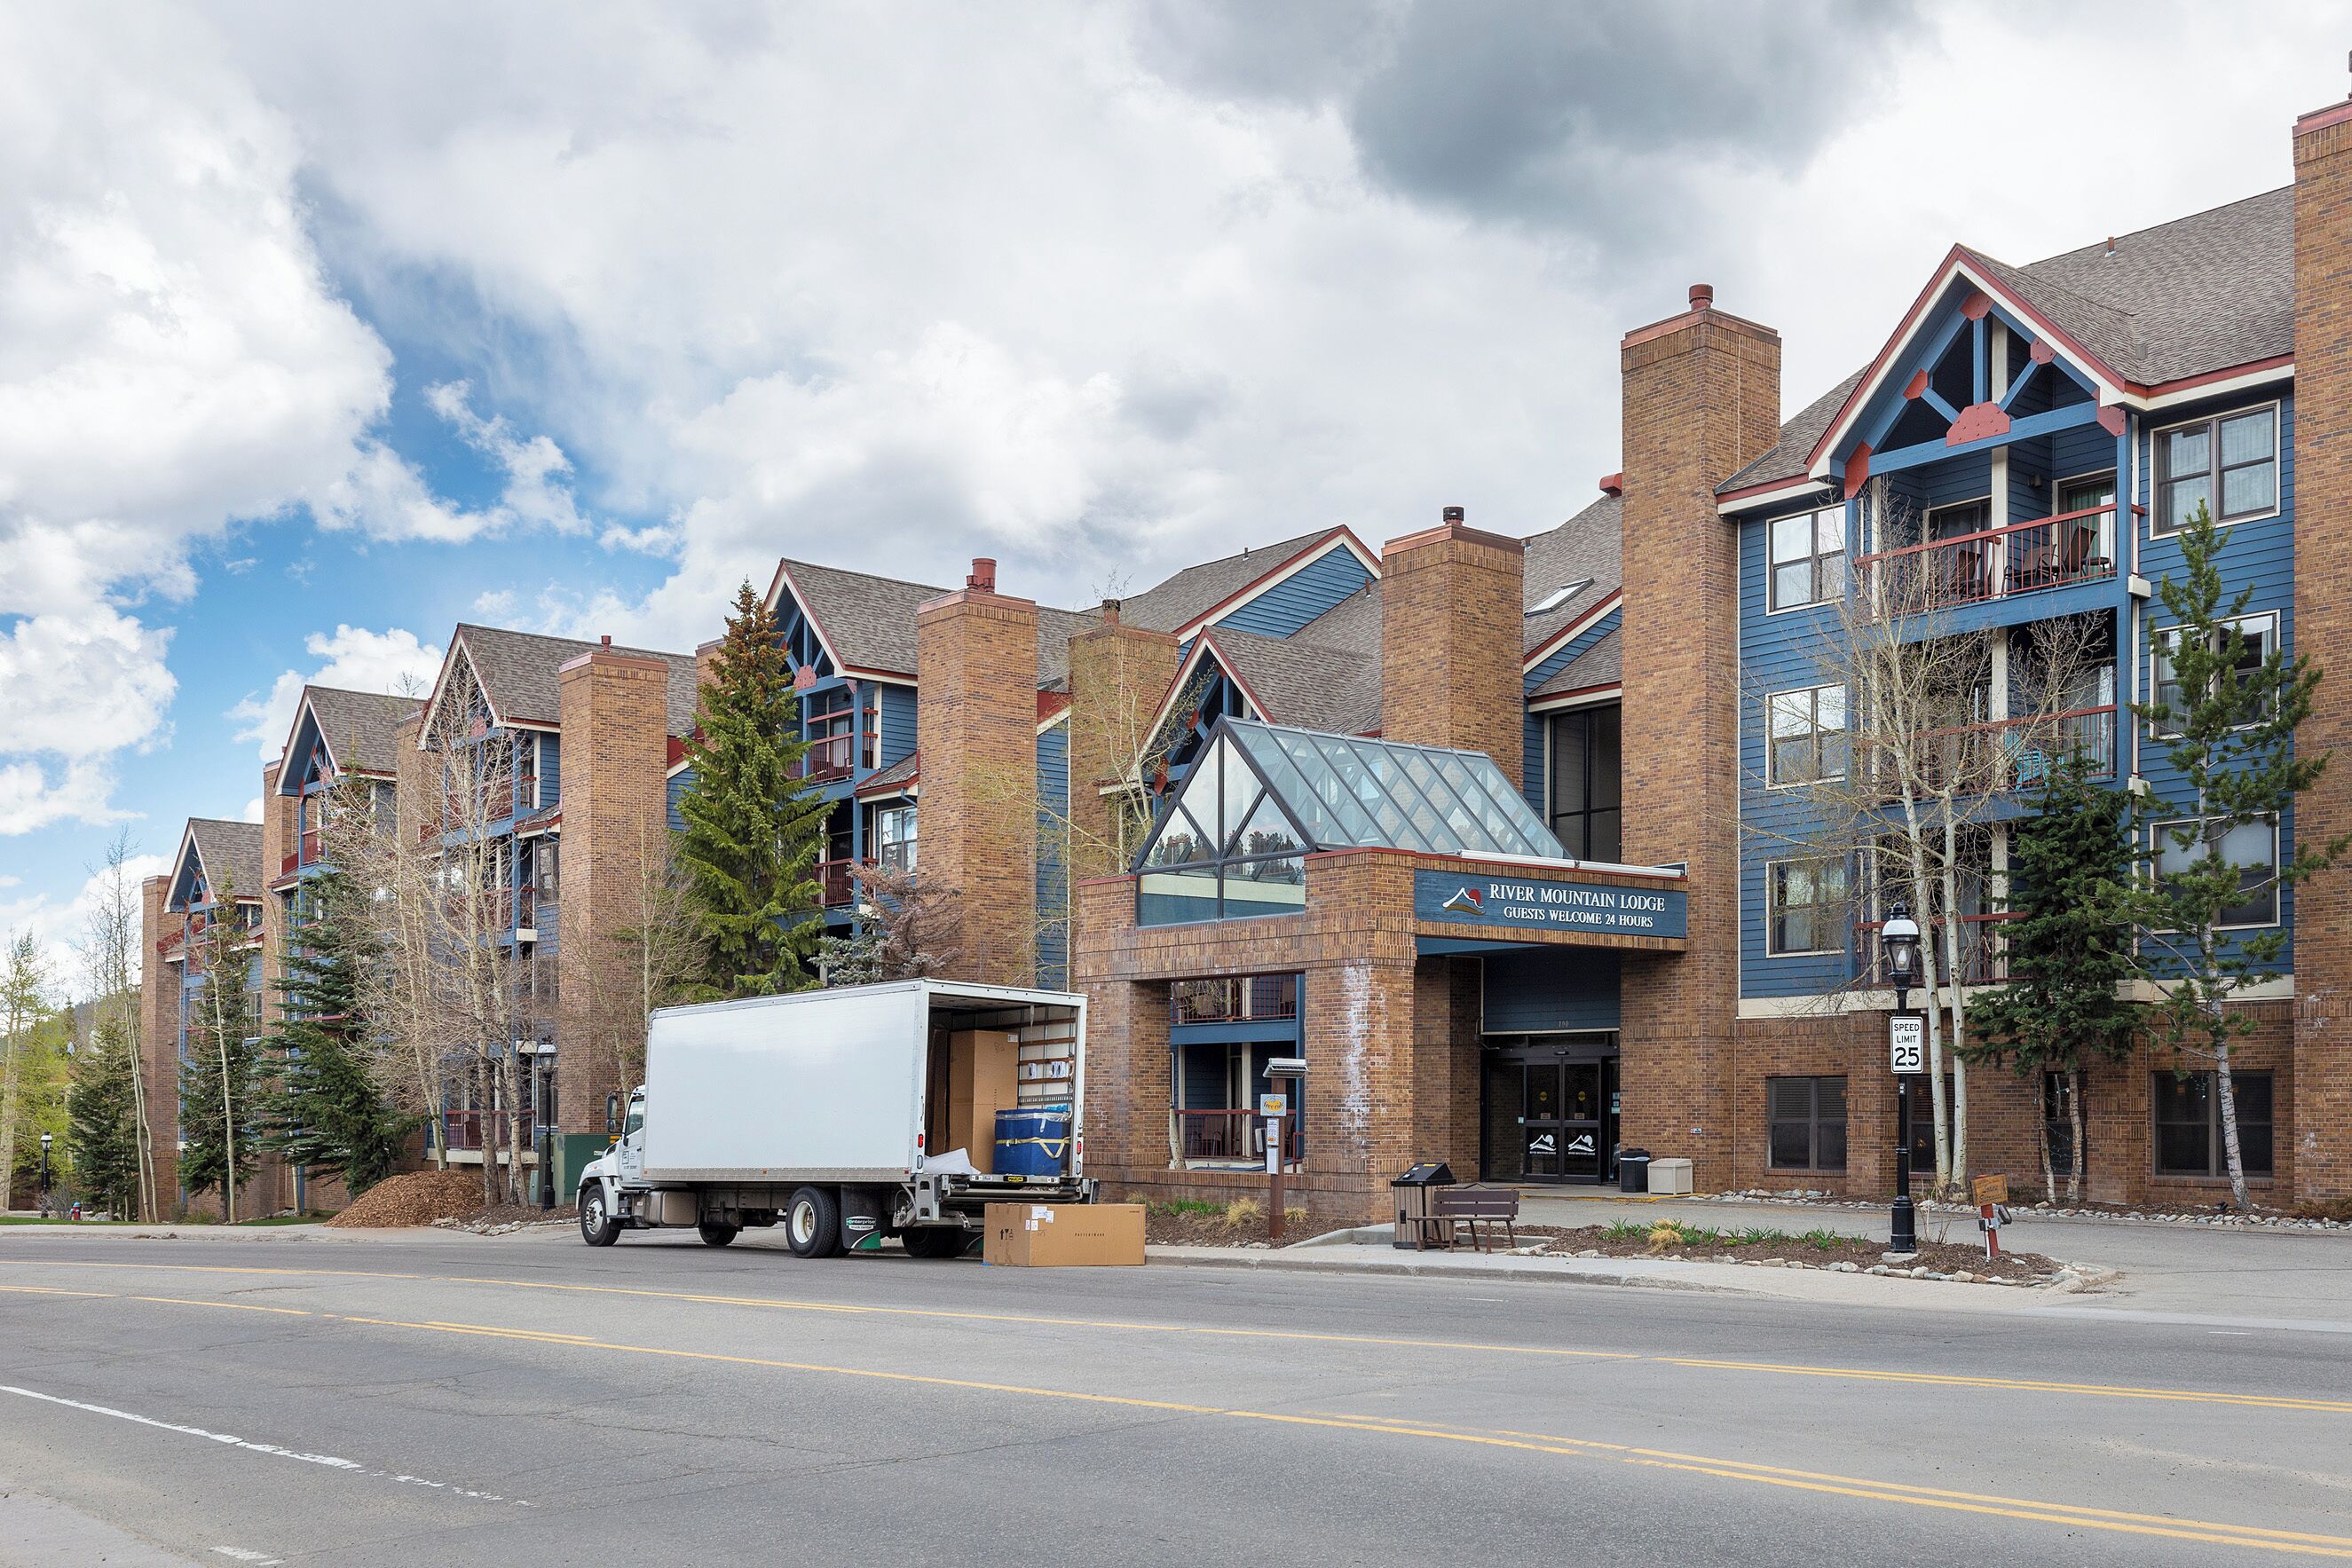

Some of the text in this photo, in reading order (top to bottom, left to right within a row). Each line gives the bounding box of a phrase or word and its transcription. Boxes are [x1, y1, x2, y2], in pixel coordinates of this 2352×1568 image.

[1489, 883, 1665, 911] RIVER MOUNTAIN LODGE
[1504, 906, 1654, 927] GUESTS WELCOME 24 HOURS
[1894, 1046, 1920, 1066] 25
